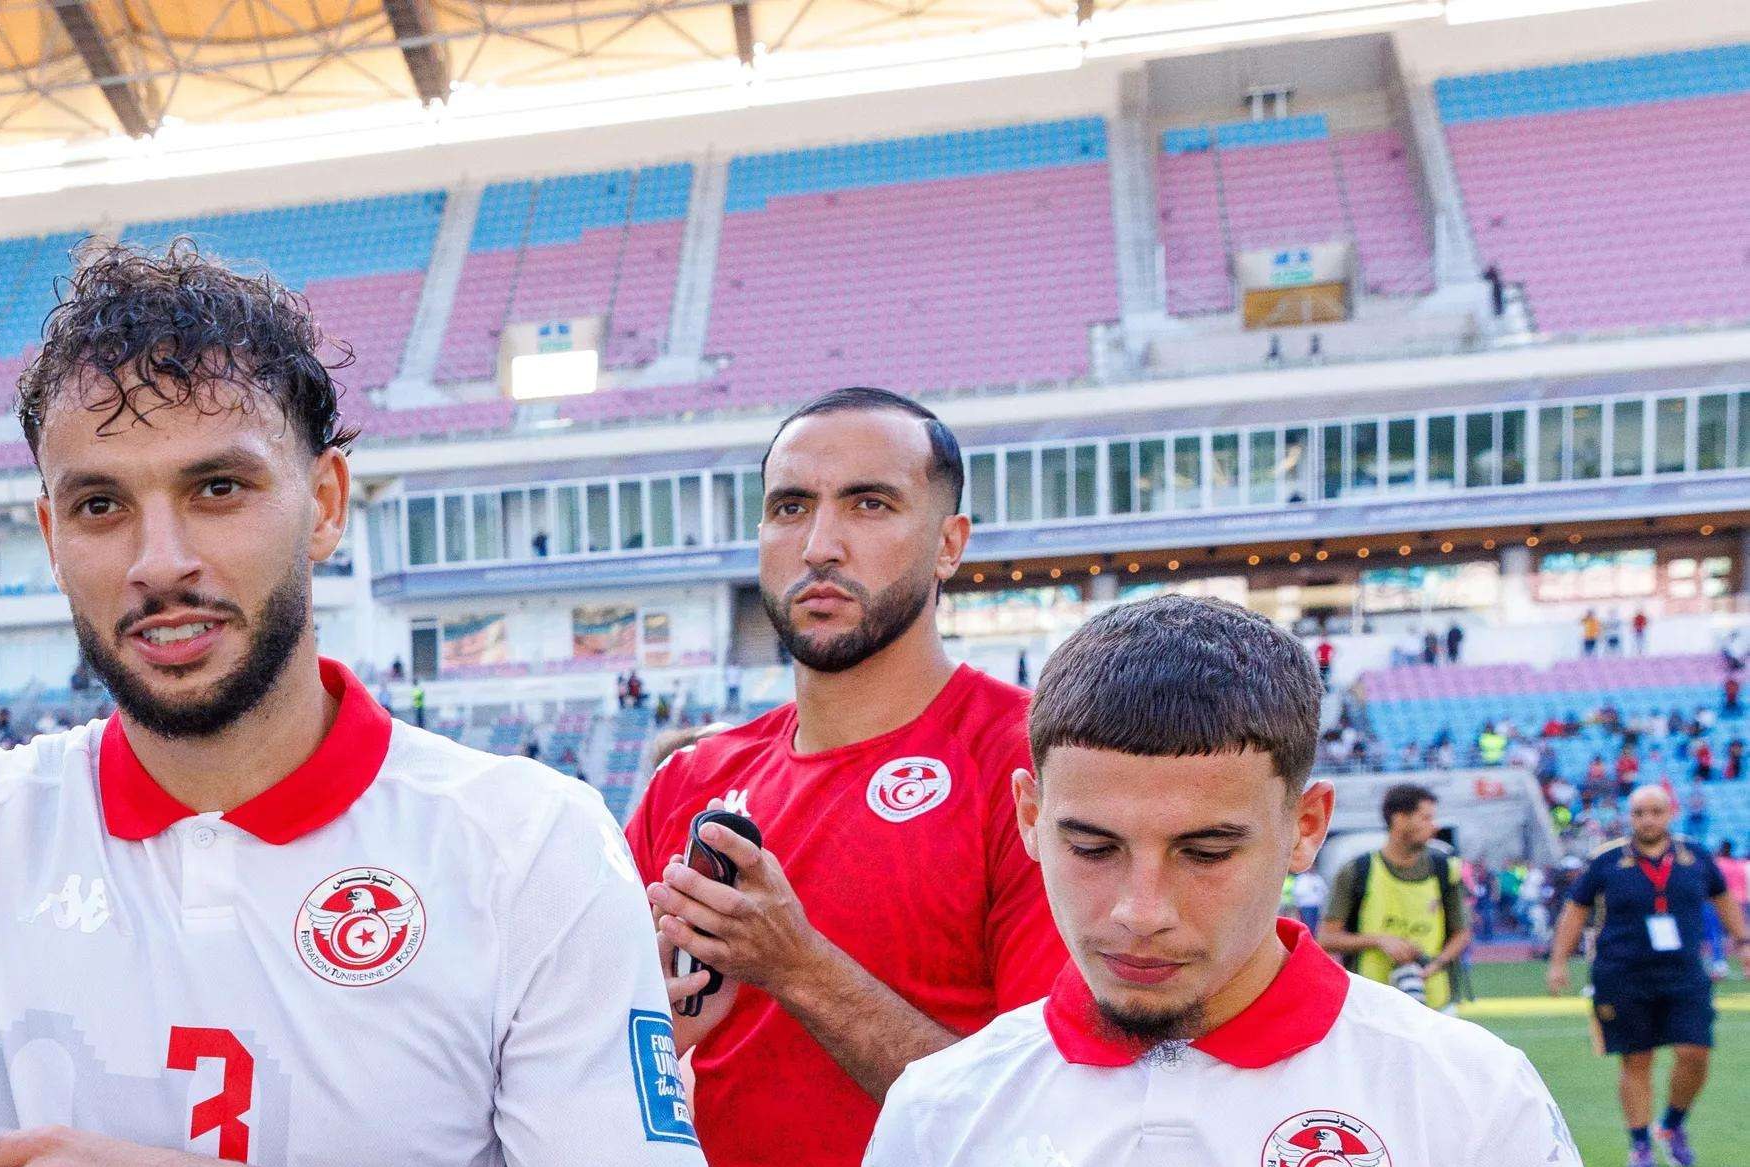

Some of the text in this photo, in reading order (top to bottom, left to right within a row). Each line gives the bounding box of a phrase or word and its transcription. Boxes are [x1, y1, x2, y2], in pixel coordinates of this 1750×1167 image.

[330, 968, 385, 981] TUNISIENNE
[385, 963, 398, 973] DE
[167, 1026, 254, 1164] 3
